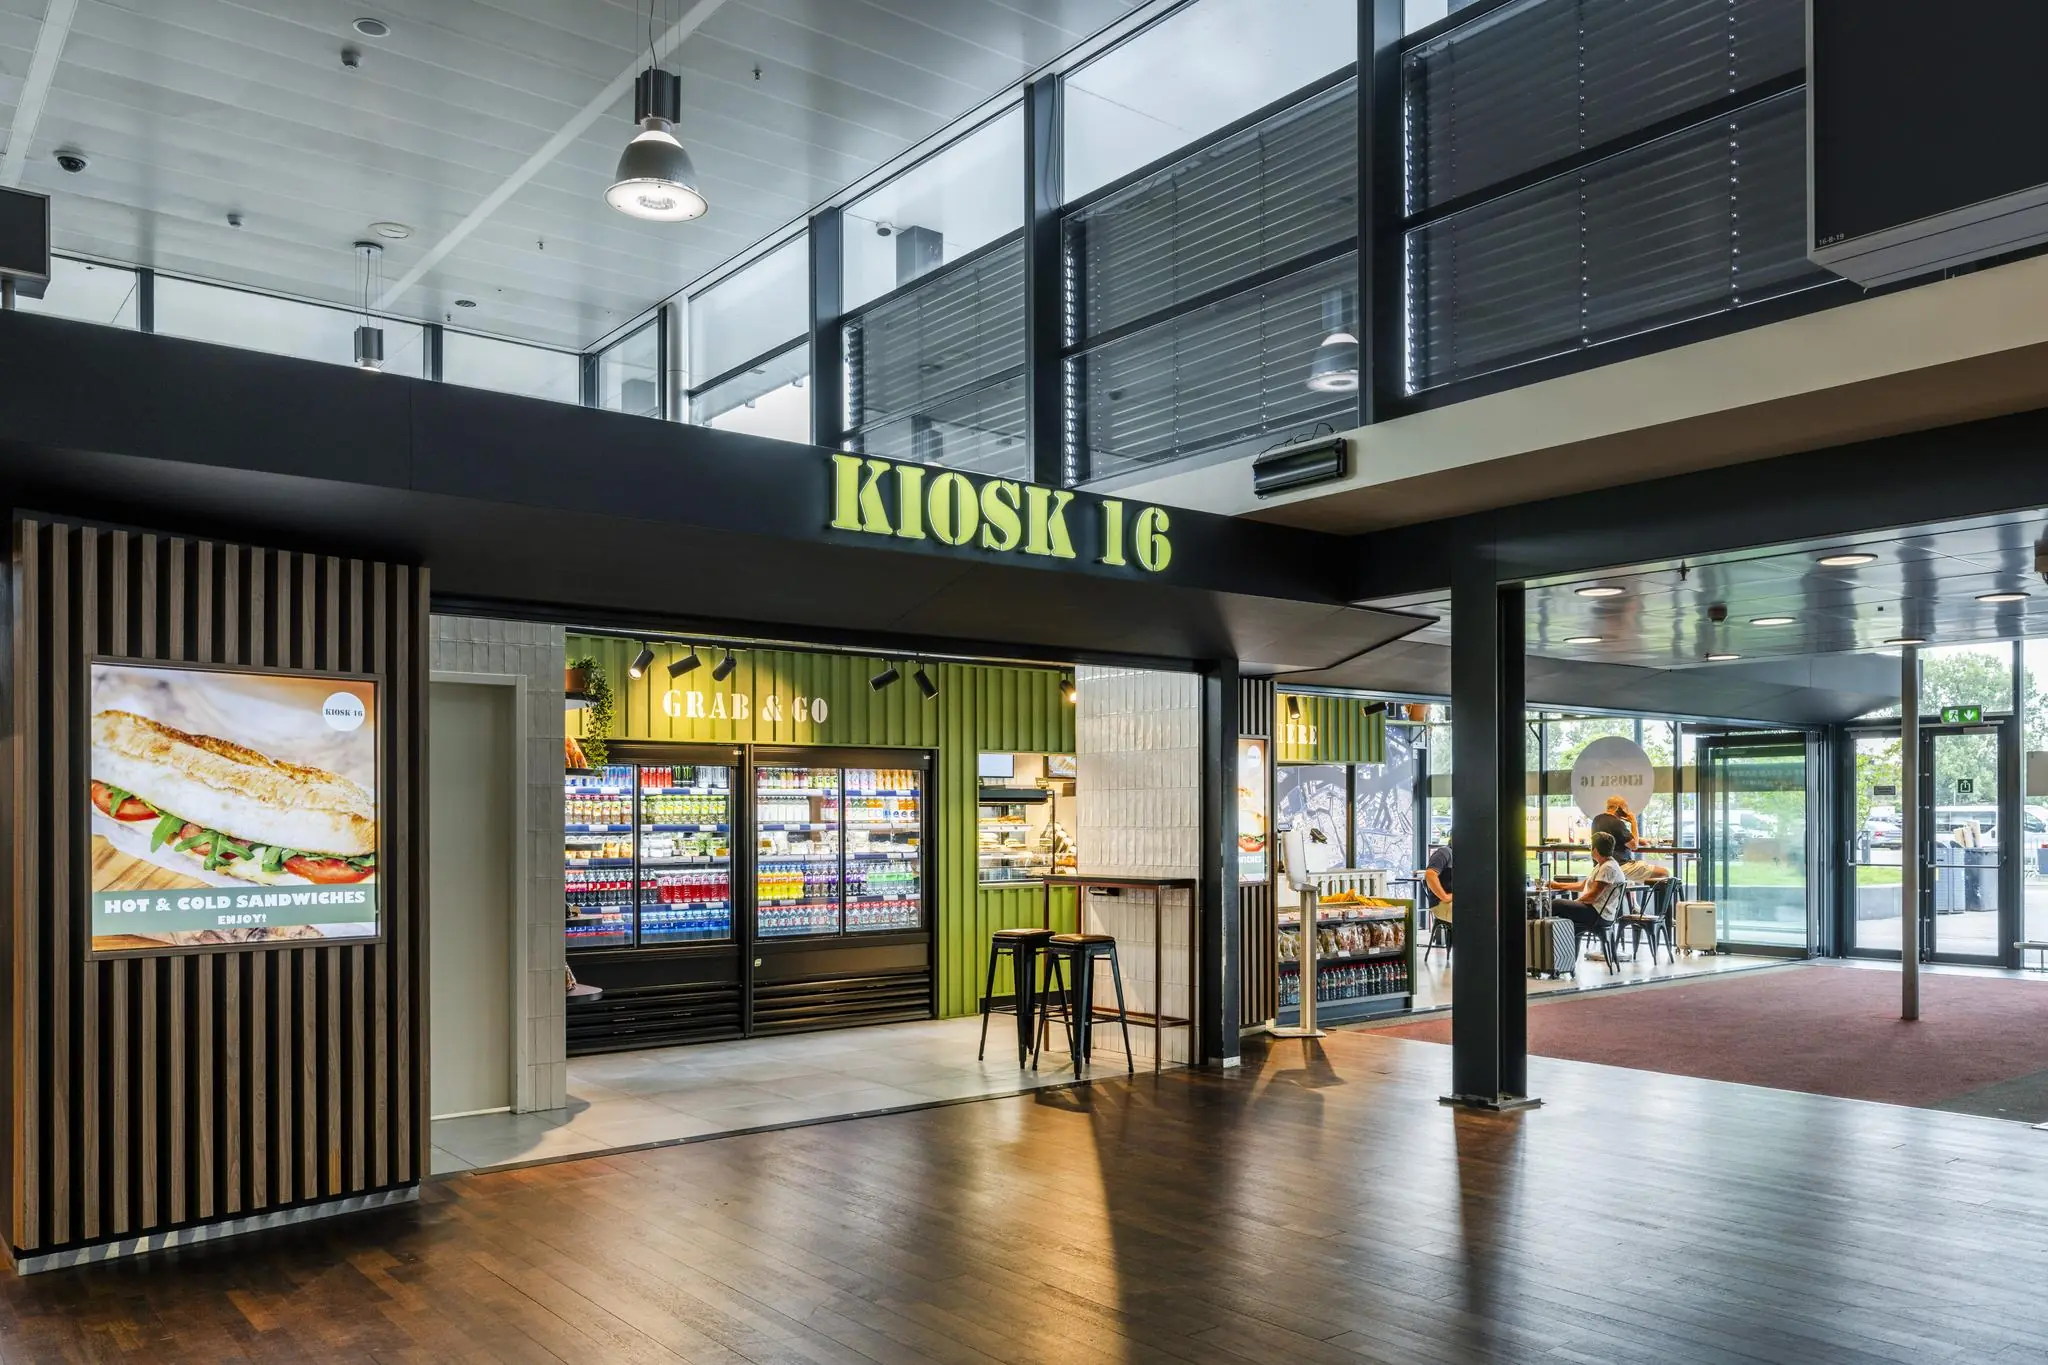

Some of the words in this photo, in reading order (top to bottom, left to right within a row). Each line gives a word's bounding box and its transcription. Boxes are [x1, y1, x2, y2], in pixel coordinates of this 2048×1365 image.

[831, 453, 1077, 560] KIOSK
[1100, 499, 1173, 573] 16
[325, 707, 351, 717] KIOSK
[353, 709, 364, 717] 16
[662, 689, 750, 721] GRAB
[761, 694, 783, 722] &
[791, 696, 829, 724] GO
[104, 898, 150, 914] HOT
[155, 898, 172, 913] &
[177, 895, 232, 911] COLD
[235, 890, 366, 908] SANDWICHES
[217, 913, 267, 925] ENJOY!
